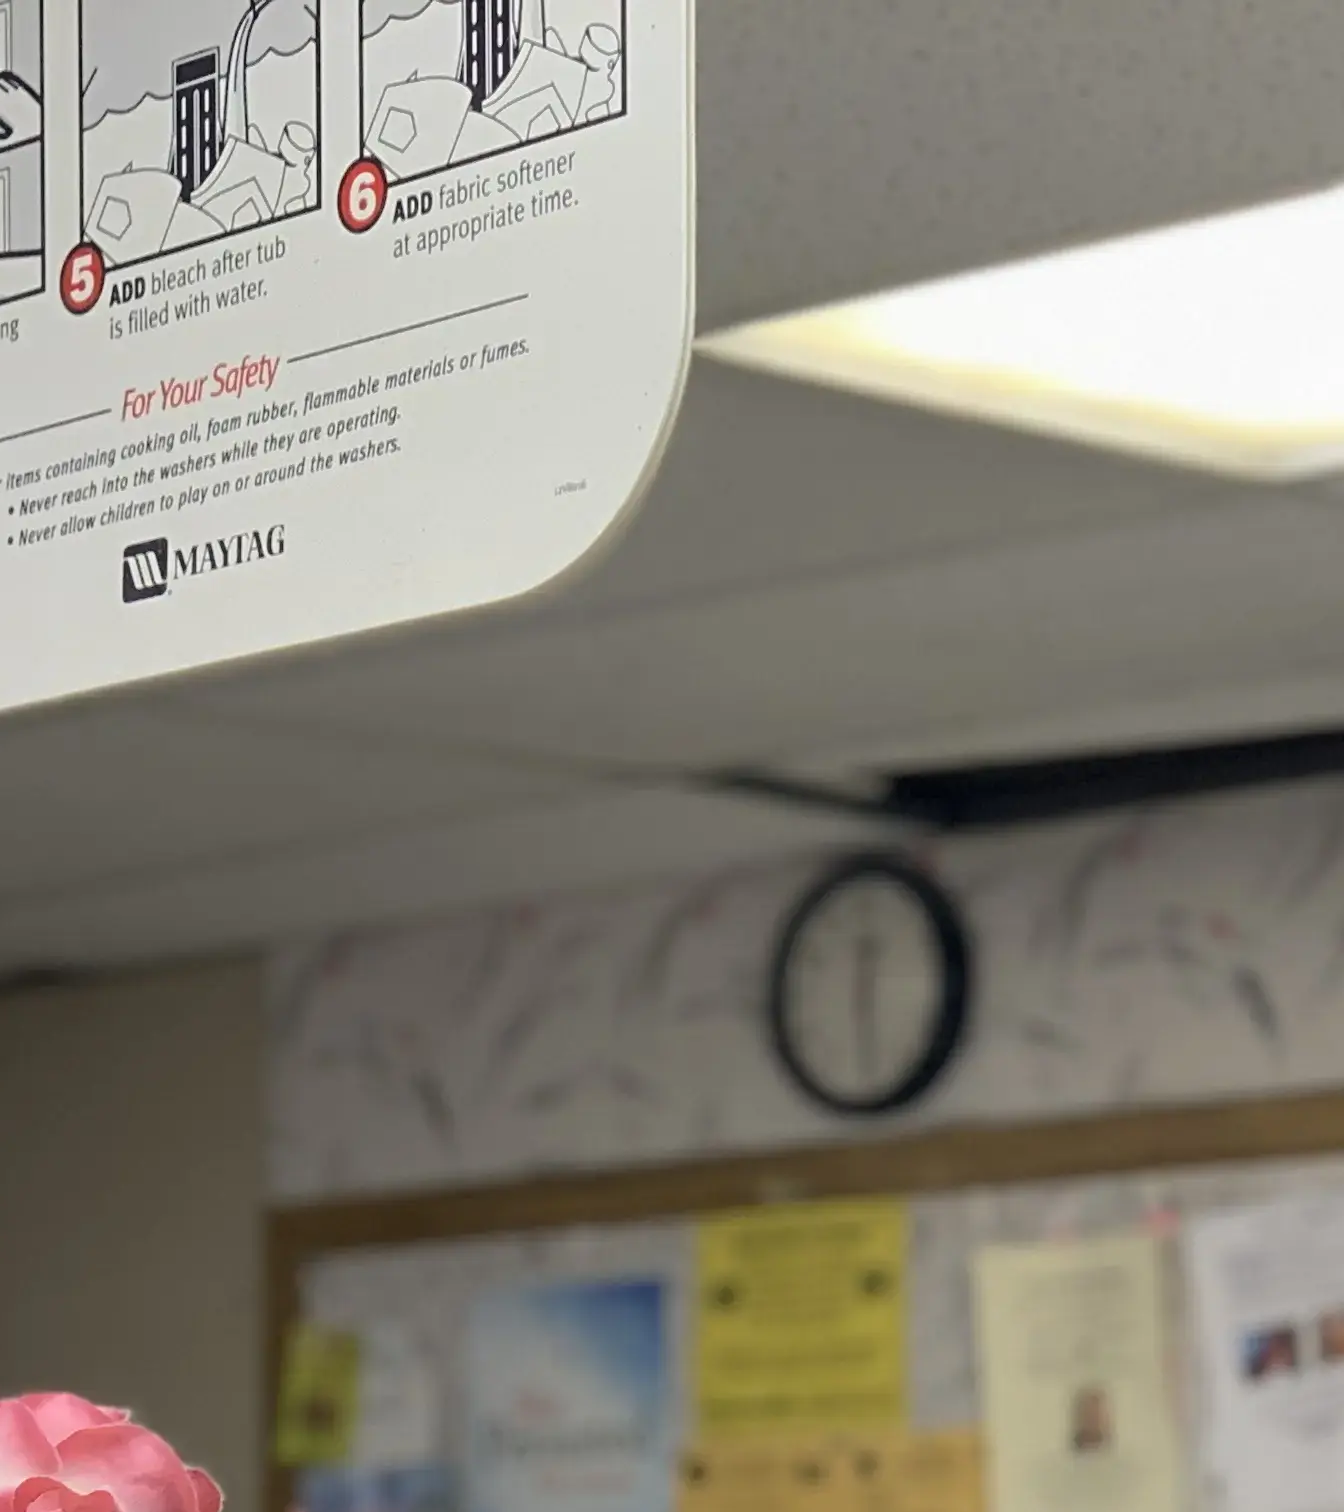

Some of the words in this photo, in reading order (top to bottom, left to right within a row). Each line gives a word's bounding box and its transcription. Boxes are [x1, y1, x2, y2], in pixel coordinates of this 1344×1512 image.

[349, 171, 376, 221] 6
[392, 191, 433, 224] ADD
[439, 174, 491, 209] fabric
[496, 150, 576, 193] softener
[393, 234, 410, 259] at
[416, 202, 525, 254] appropriate
[531, 187, 579, 218] time.
[70, 253, 94, 301] 5
[109, 276, 146, 308] ADD
[151, 258, 206, 295] bleach
[212, 249, 251, 279] after
[257, 235, 286, 264] tub
[109, 317, 123, 340] is
[128, 301, 169, 335] filled
[174, 291, 210, 321] with
[215, 278, 268, 310] water.
[5, 467, 42, 491] items
[45, 448, 117, 480] containing
[121, 430, 175, 461] cooking
[180, 423, 201, 444] oil,
[207, 415, 241, 442] foam
[247, 400, 298, 427] rubber,
[303, 375, 379, 416] flammable
[385, 355, 454, 391] materials
[460, 351, 477, 371] or
[480, 338, 530, 370] fumes.
[121, 387, 156, 422] For
[160, 375, 208, 411] Your
[210, 354, 281, 399] Safety
[18, 525, 57, 546] Never
[60, 514, 96, 537] allow
[100, 499, 155, 526] children
[160, 494, 174, 512] to
[178, 480, 208, 511] play
[212, 480, 230, 497] on
[235, 474, 251, 492] or
[255, 456, 306, 487] around
[310, 452, 333, 474] the
[339, 437, 401, 466] washers.
[19, 492, 58, 517] Never
[61, 481, 97, 507] reach
[102, 477, 129, 496] into
[133, 467, 155, 488] the
[160, 451, 216, 480] washers
[221, 441, 258, 465] while
[263, 432, 295, 455] they
[299, 426, 322, 445] are
[327, 405, 401, 440] operating.
[173, 524, 285, 580] MAYTAG
